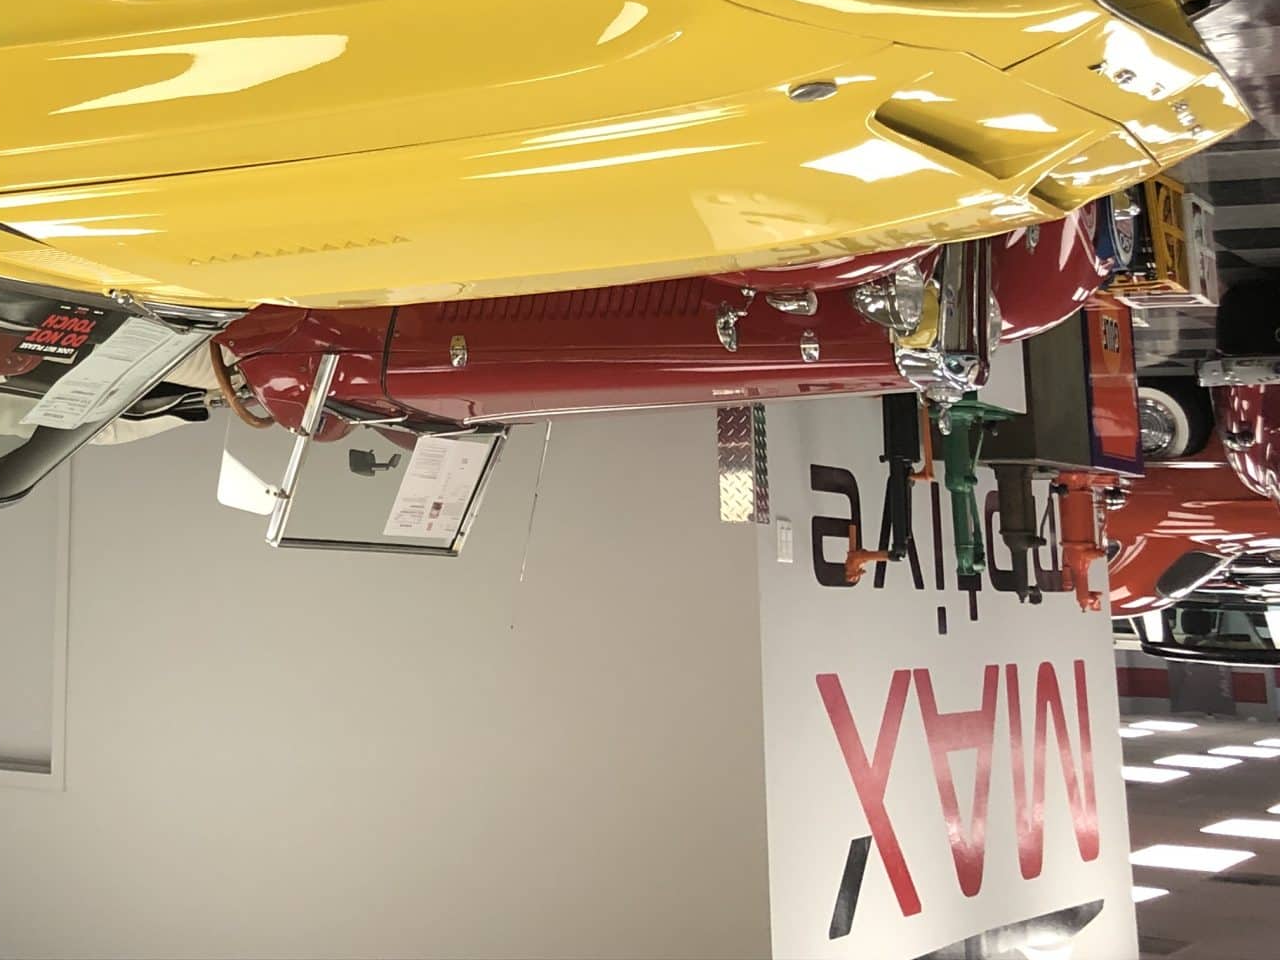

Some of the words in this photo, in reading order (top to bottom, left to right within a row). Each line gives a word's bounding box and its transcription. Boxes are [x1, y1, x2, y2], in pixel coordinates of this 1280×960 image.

[41, 314, 96, 333] TOUCH
[25, 330, 65, 345] NOT
[61, 333, 89, 347] DO
[815, 659, 1100, 940] MAX
